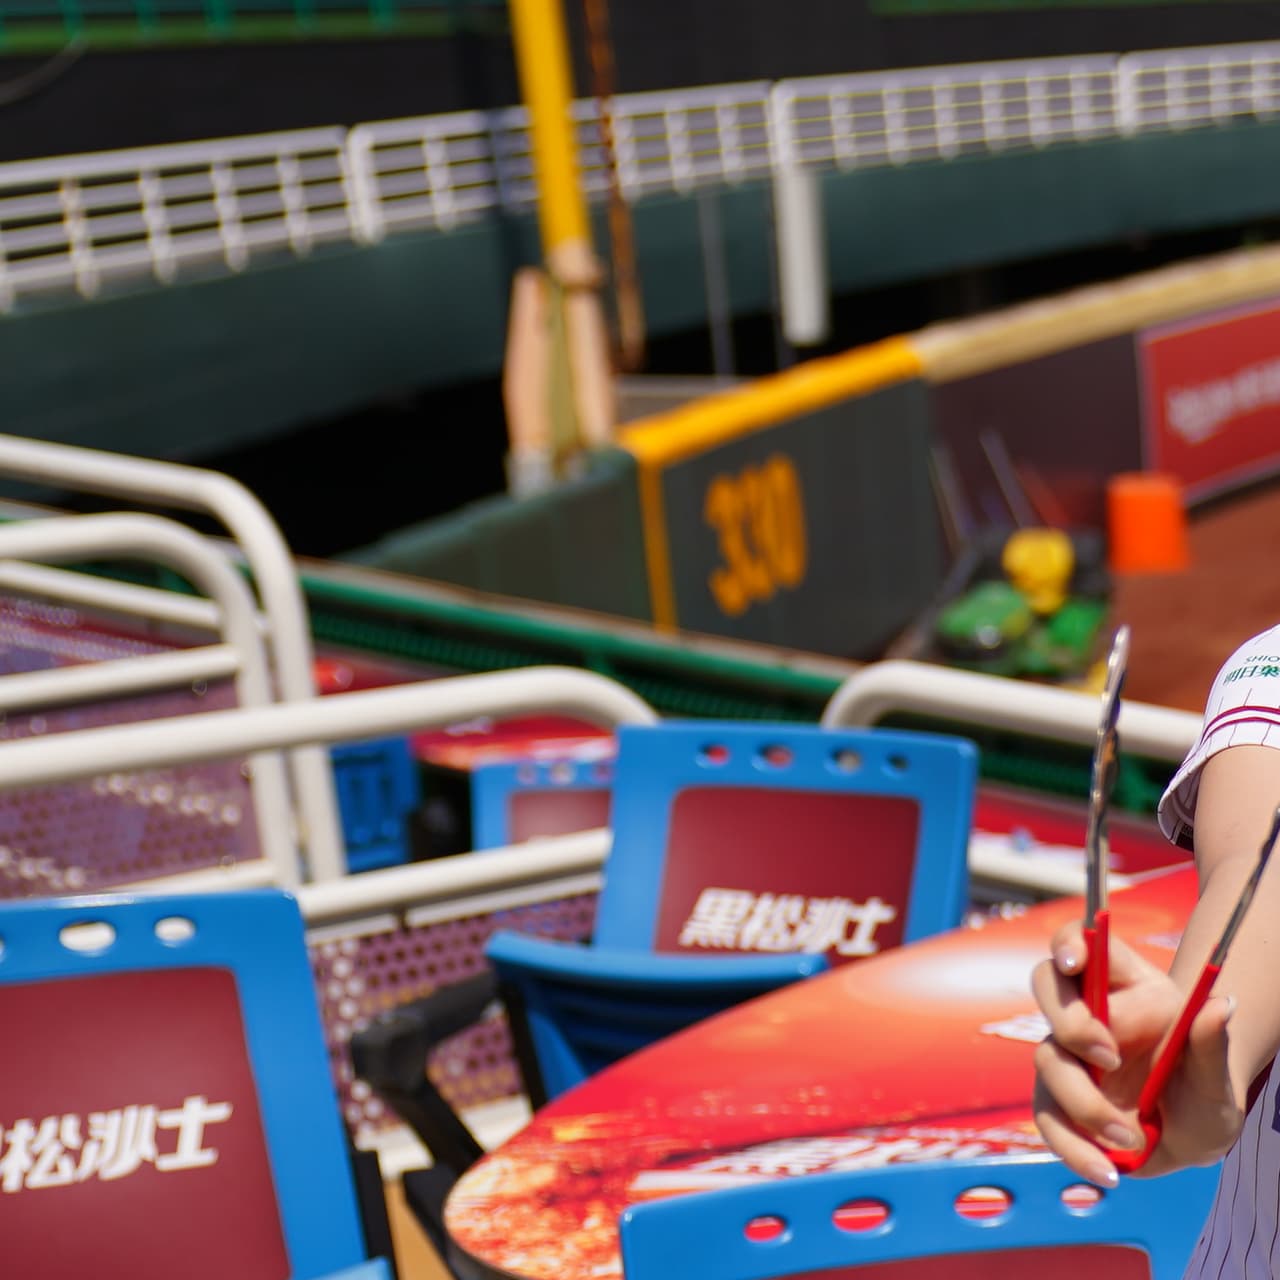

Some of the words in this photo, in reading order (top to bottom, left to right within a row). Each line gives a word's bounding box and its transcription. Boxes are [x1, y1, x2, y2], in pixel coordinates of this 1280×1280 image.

[704, 454, 806, 618] 330
[679, 887, 896, 956] 黑松沙士
[0, 1095, 233, 1192] 松沙士
